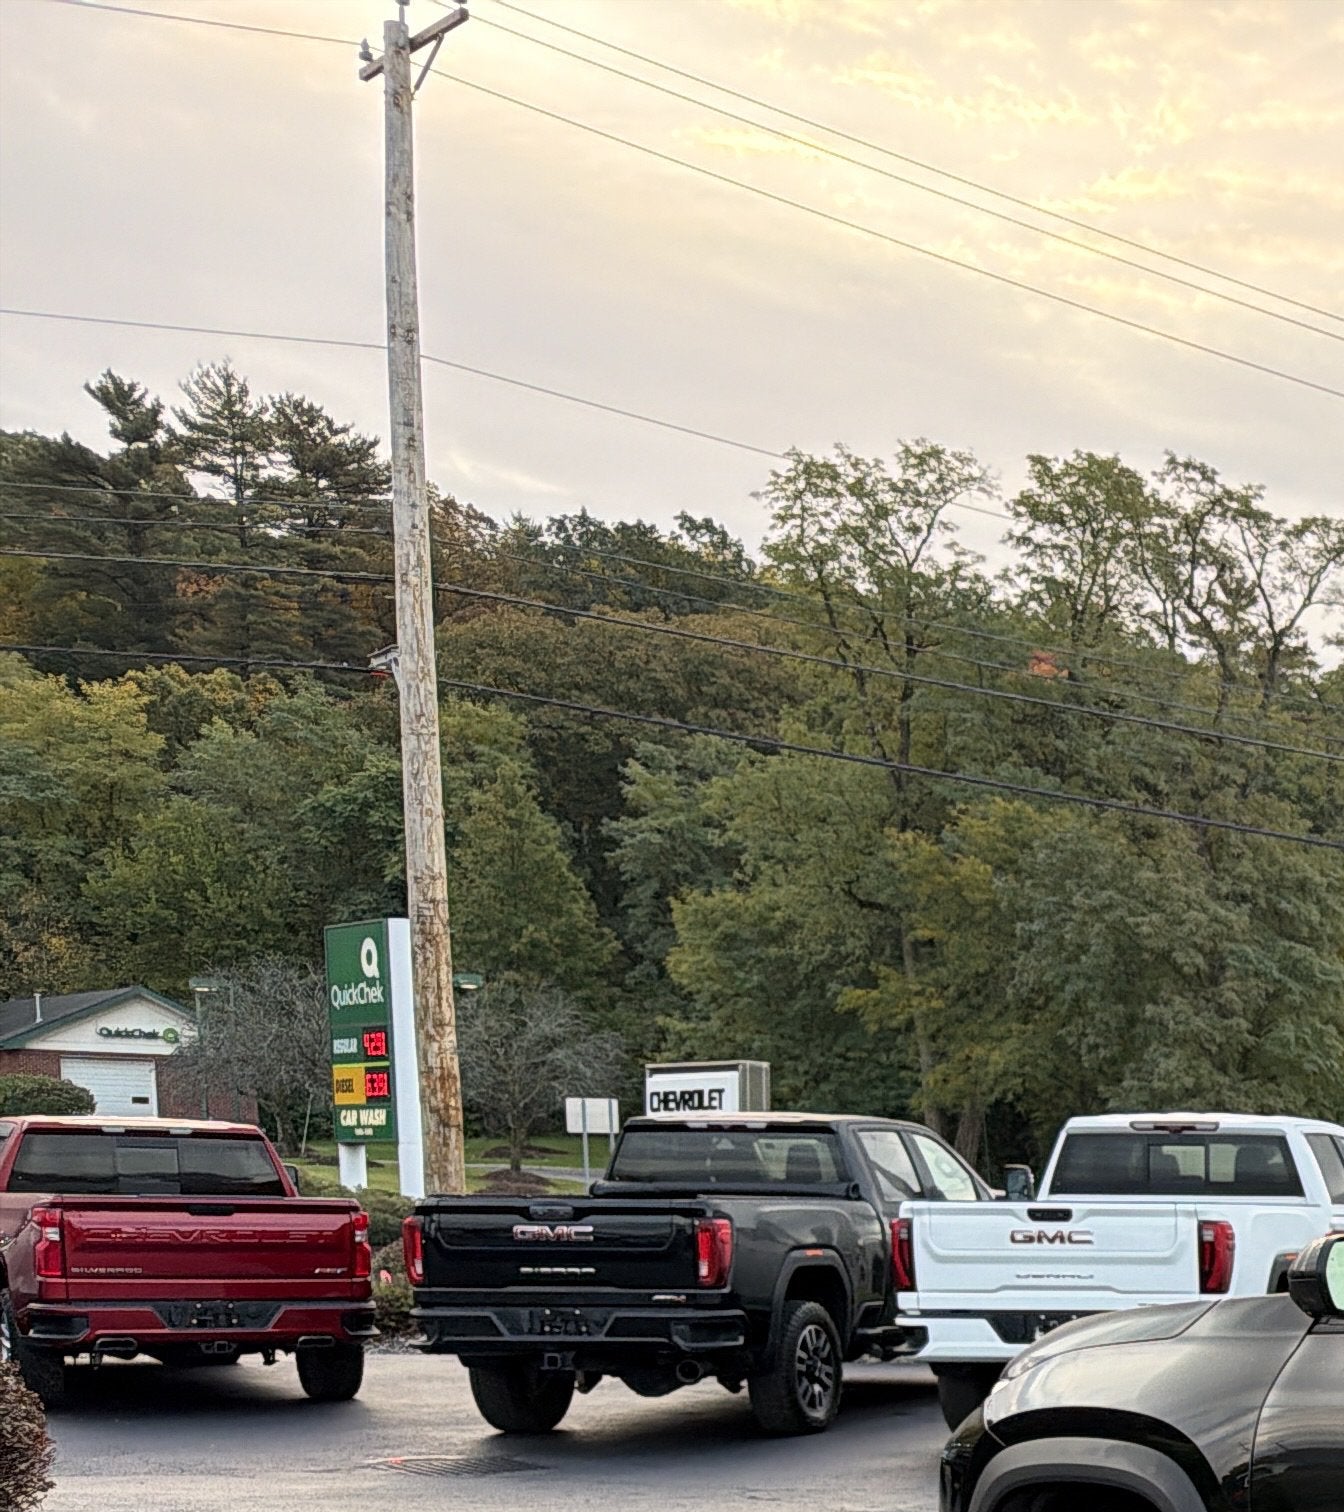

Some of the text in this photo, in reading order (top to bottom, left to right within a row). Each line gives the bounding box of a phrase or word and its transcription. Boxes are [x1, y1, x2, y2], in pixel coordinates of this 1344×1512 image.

[331, 981, 385, 1010] QuickChek
[650, 1088, 725, 1112] CHEVROLET
[340, 1108, 387, 1127] CAR WASH
[513, 1224, 594, 1242] GMC
[1010, 1229, 1094, 1245] GMC
